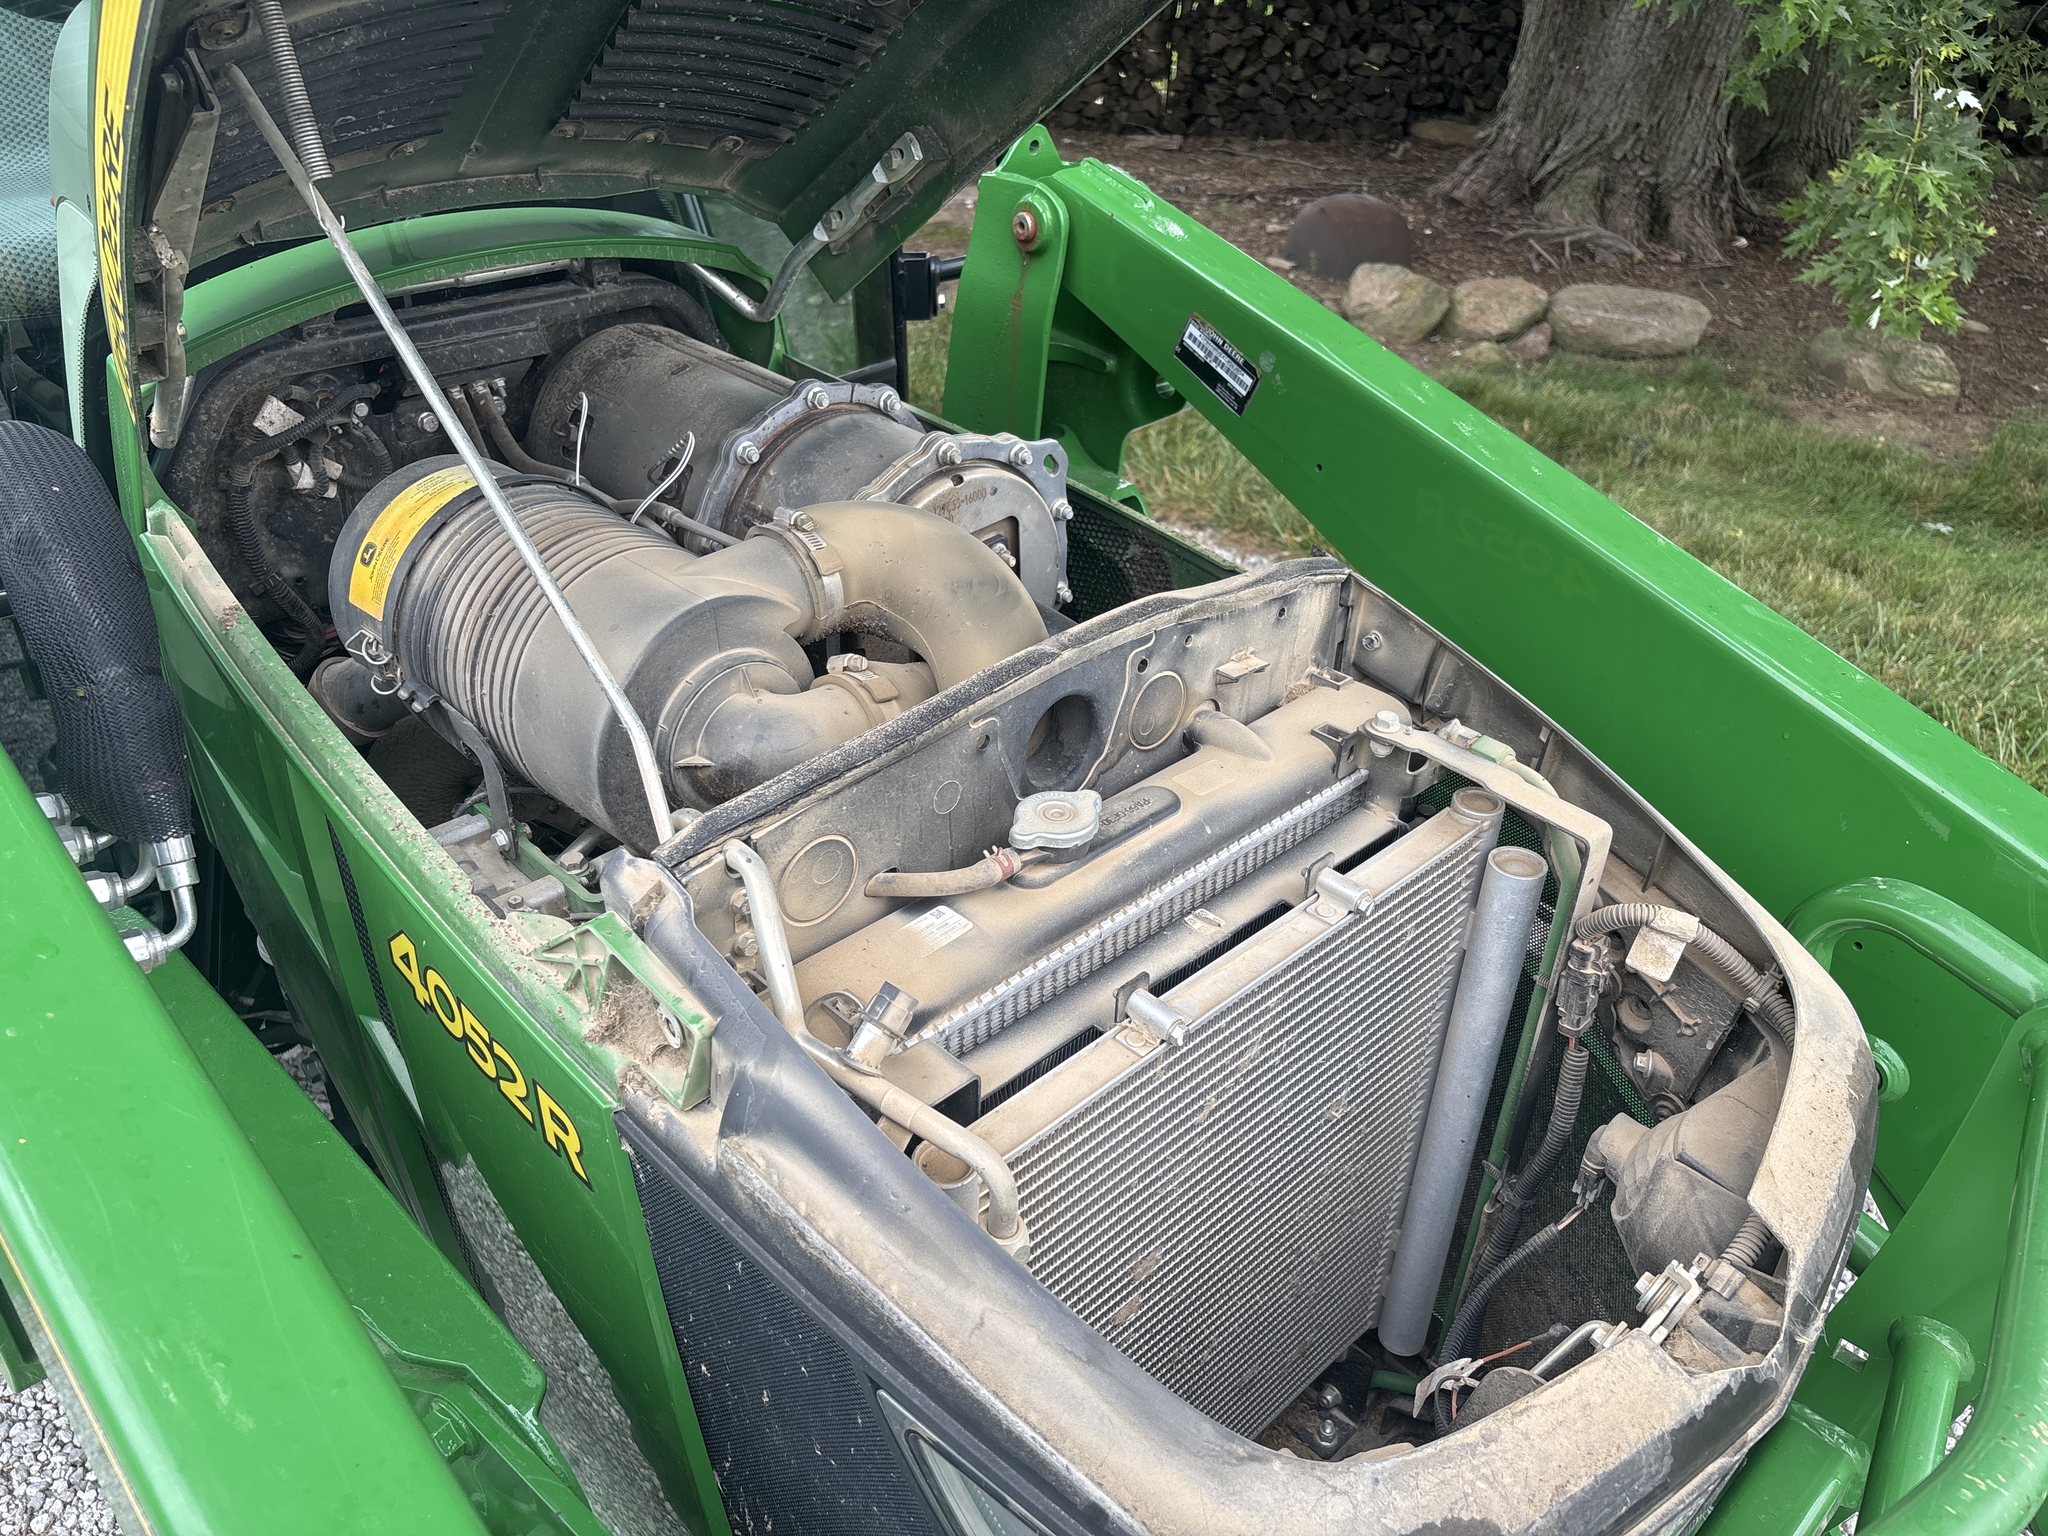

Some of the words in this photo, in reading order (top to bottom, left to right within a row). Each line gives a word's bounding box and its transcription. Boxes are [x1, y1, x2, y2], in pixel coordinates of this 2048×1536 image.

[102, 80, 124, 292] DEERE
[1205, 328, 1225, 349] JOHN
[1224, 343, 1246, 367] DEERE
[369, 562, 378, 583] JOHN
[375, 537, 390, 561] DEERE
[388, 930, 594, 1192] 4052R
